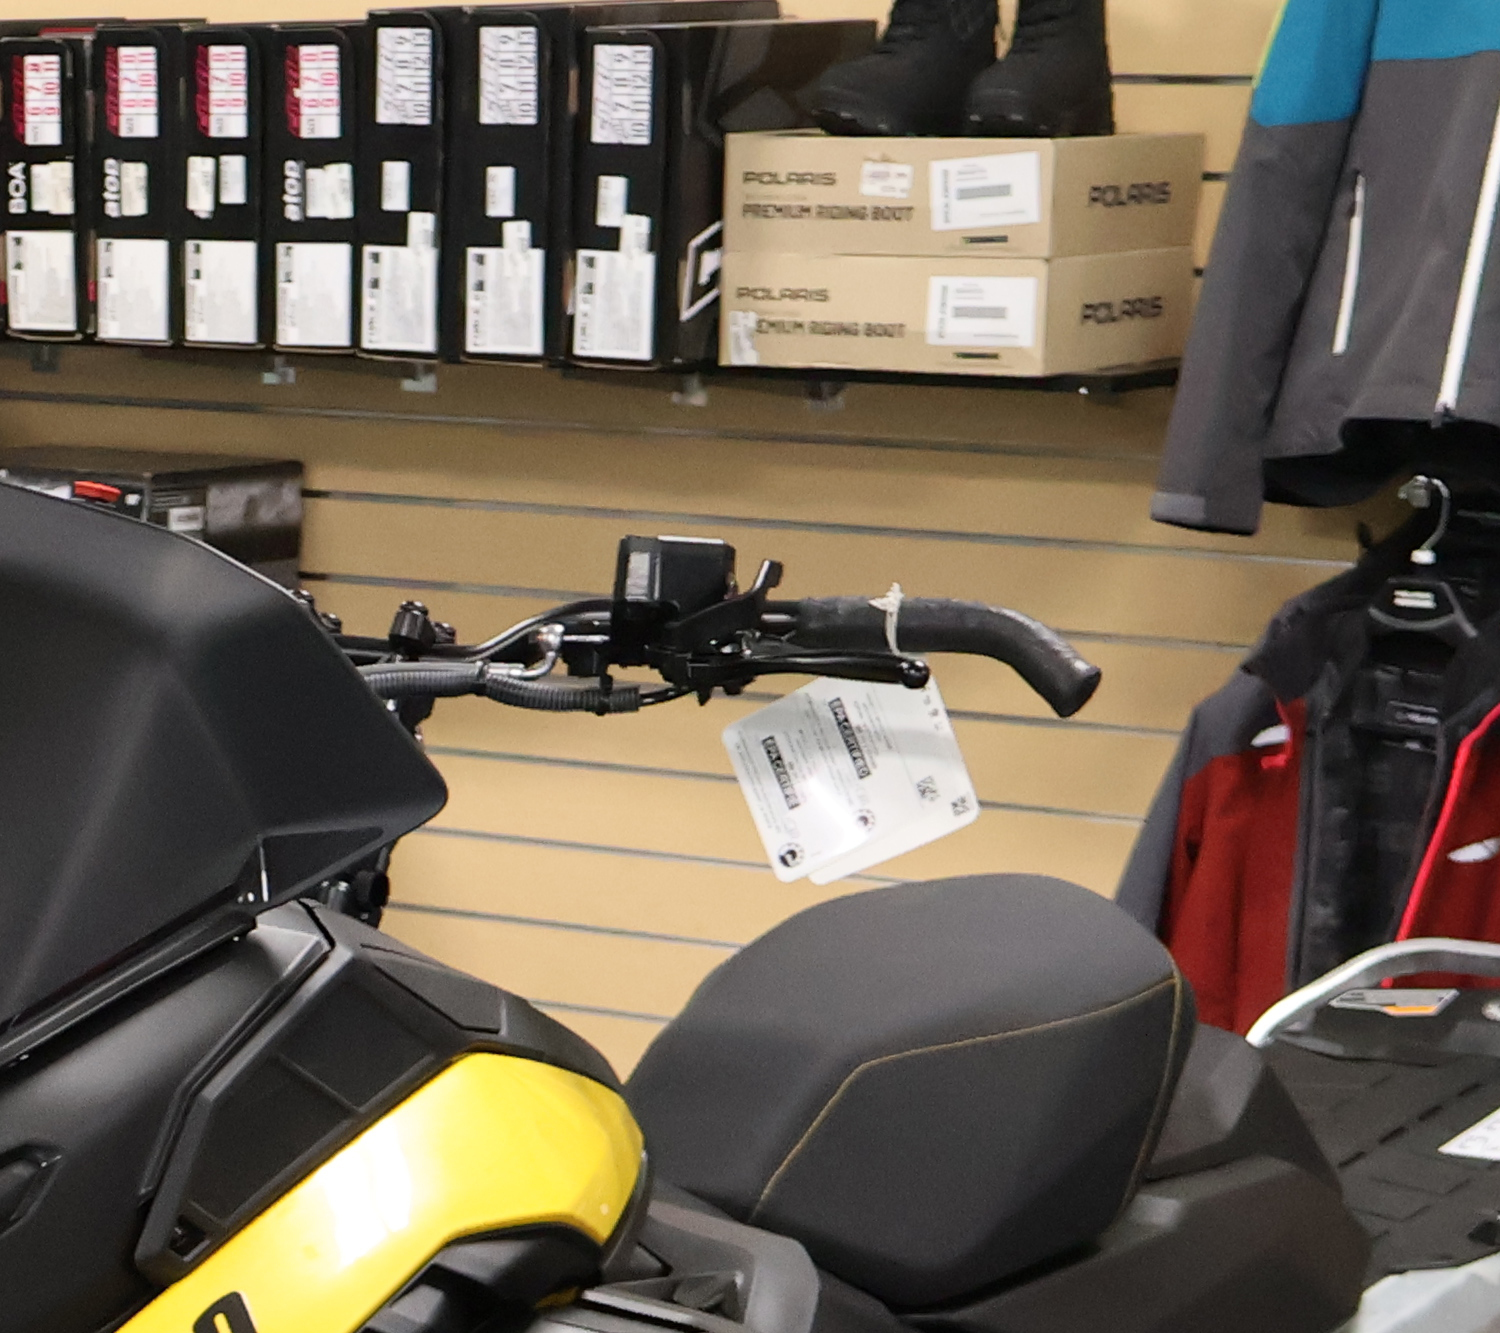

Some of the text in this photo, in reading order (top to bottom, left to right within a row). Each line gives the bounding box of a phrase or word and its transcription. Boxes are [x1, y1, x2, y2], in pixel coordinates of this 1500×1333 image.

[742, 171, 837, 185] POLARIS
[1087, 181, 1172, 207] POLARIS
[742, 203, 812, 220] PREMIUM
[871, 205, 914, 222] BOOT
[736, 287, 829, 302] POLARIS
[1080, 296, 1163, 325] POLARIS
[863, 322, 906, 338] BOOT
